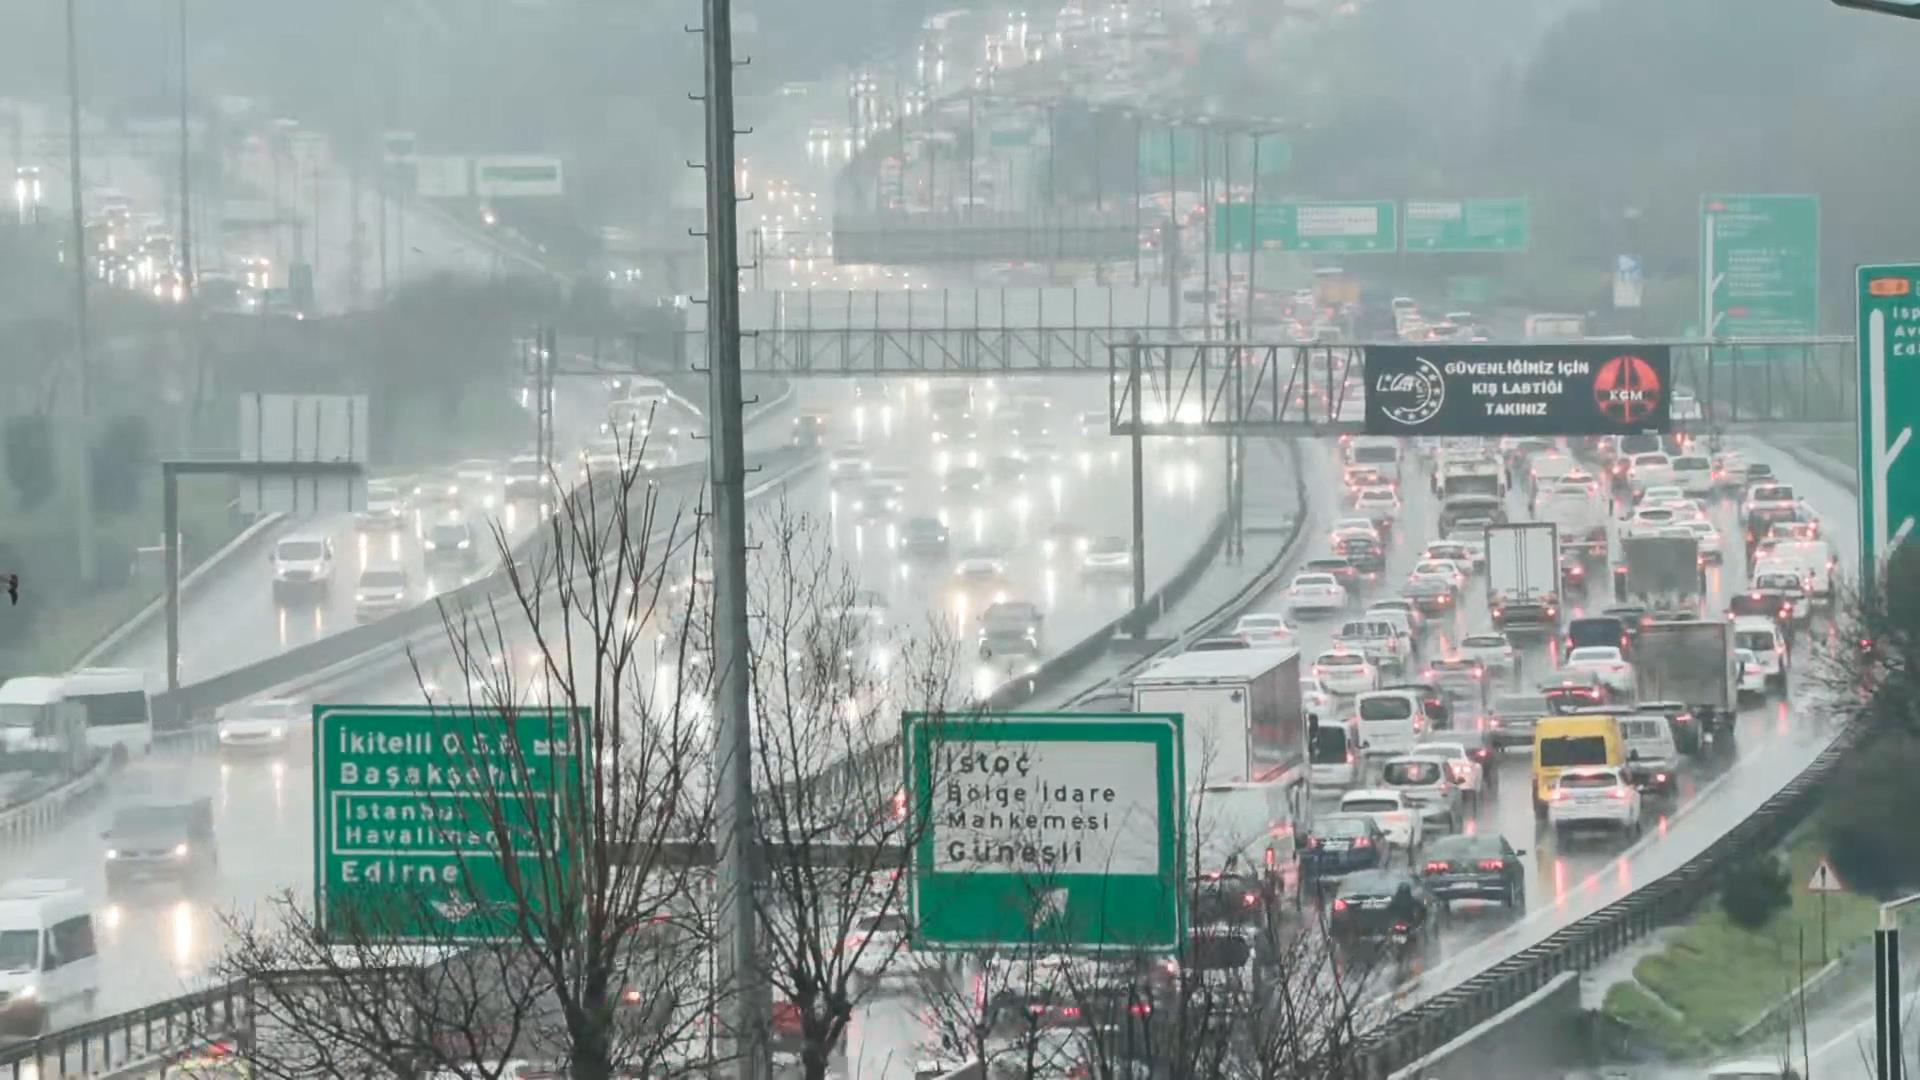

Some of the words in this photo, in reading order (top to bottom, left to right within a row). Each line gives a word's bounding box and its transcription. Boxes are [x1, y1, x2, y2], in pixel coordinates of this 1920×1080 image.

[1895, 325, 1920, 338] Av
[1558, 360, 1590, 377] İÇİN
[1472, 383, 1498, 397] KIŞ
[1485, 403, 1548, 416] TAKINIZ
[948, 812, 1109, 831] Mahkemesi
[341, 860, 459, 883] Edirne
